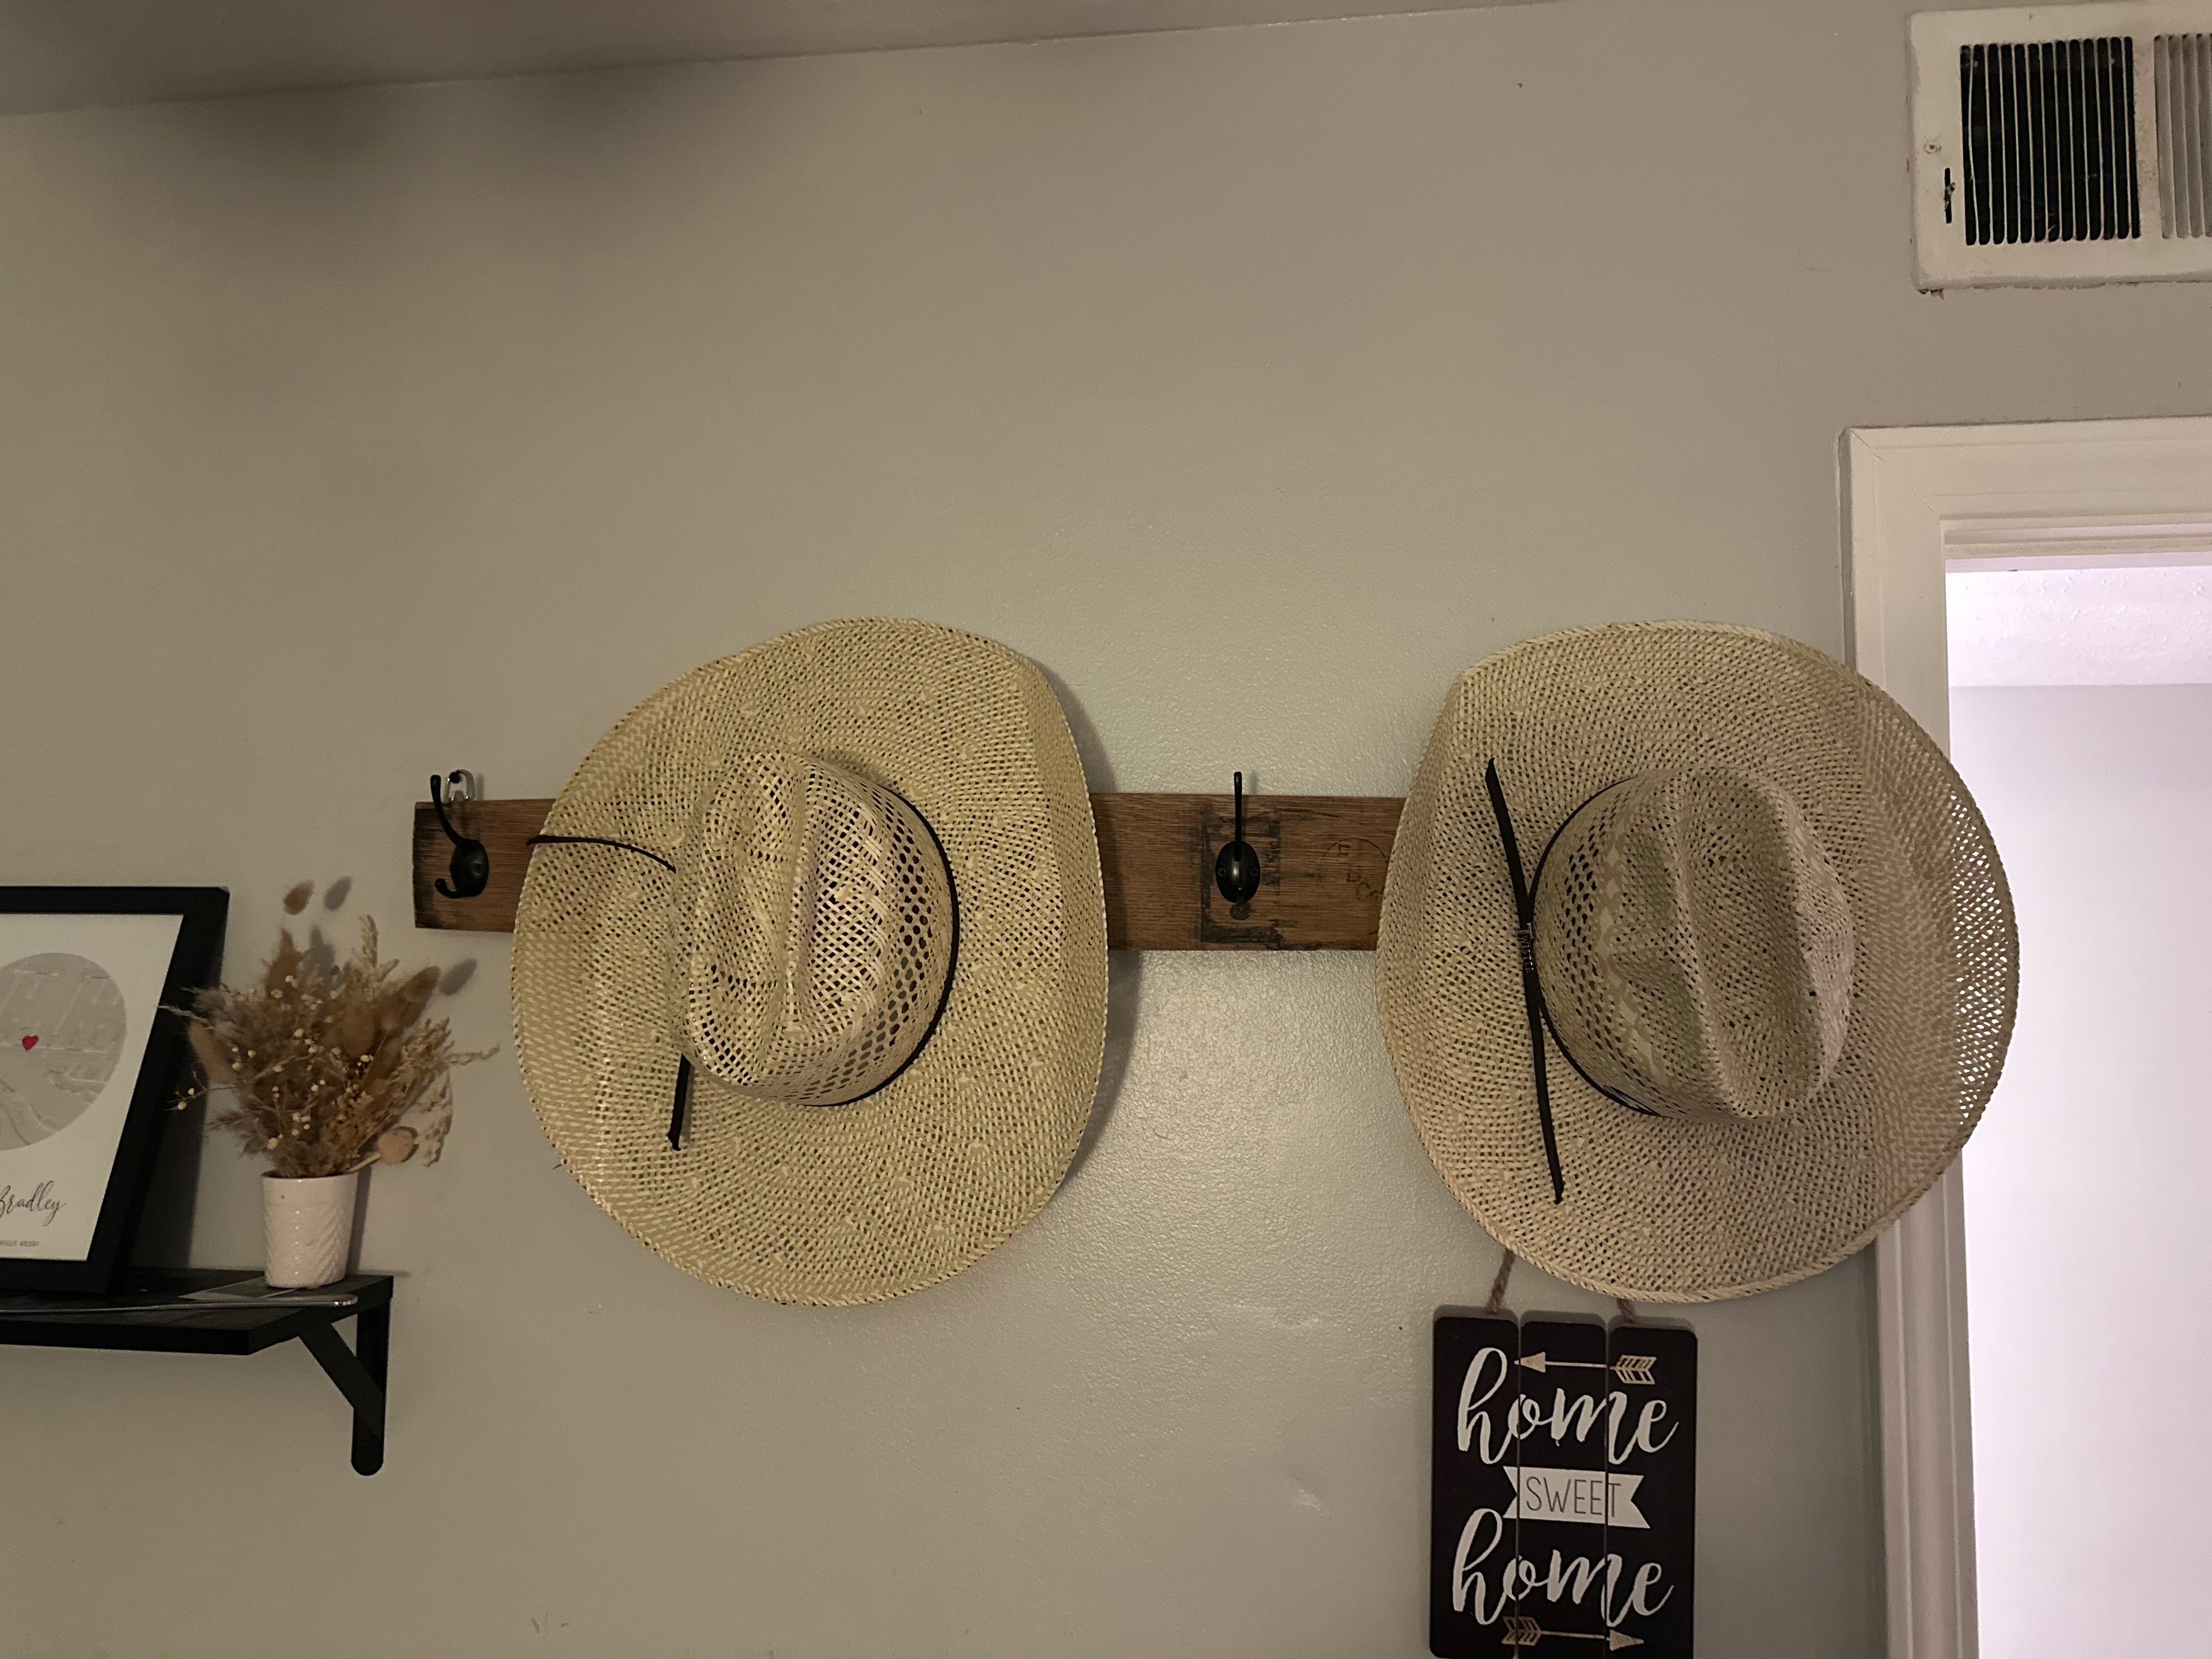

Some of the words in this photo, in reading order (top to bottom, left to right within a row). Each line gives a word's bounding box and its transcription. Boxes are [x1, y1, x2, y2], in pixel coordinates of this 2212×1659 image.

[1457, 1347, 1679, 1464] home
[1526, 1476, 1622, 1518] SWEET
[1452, 1508, 1674, 1628] home
